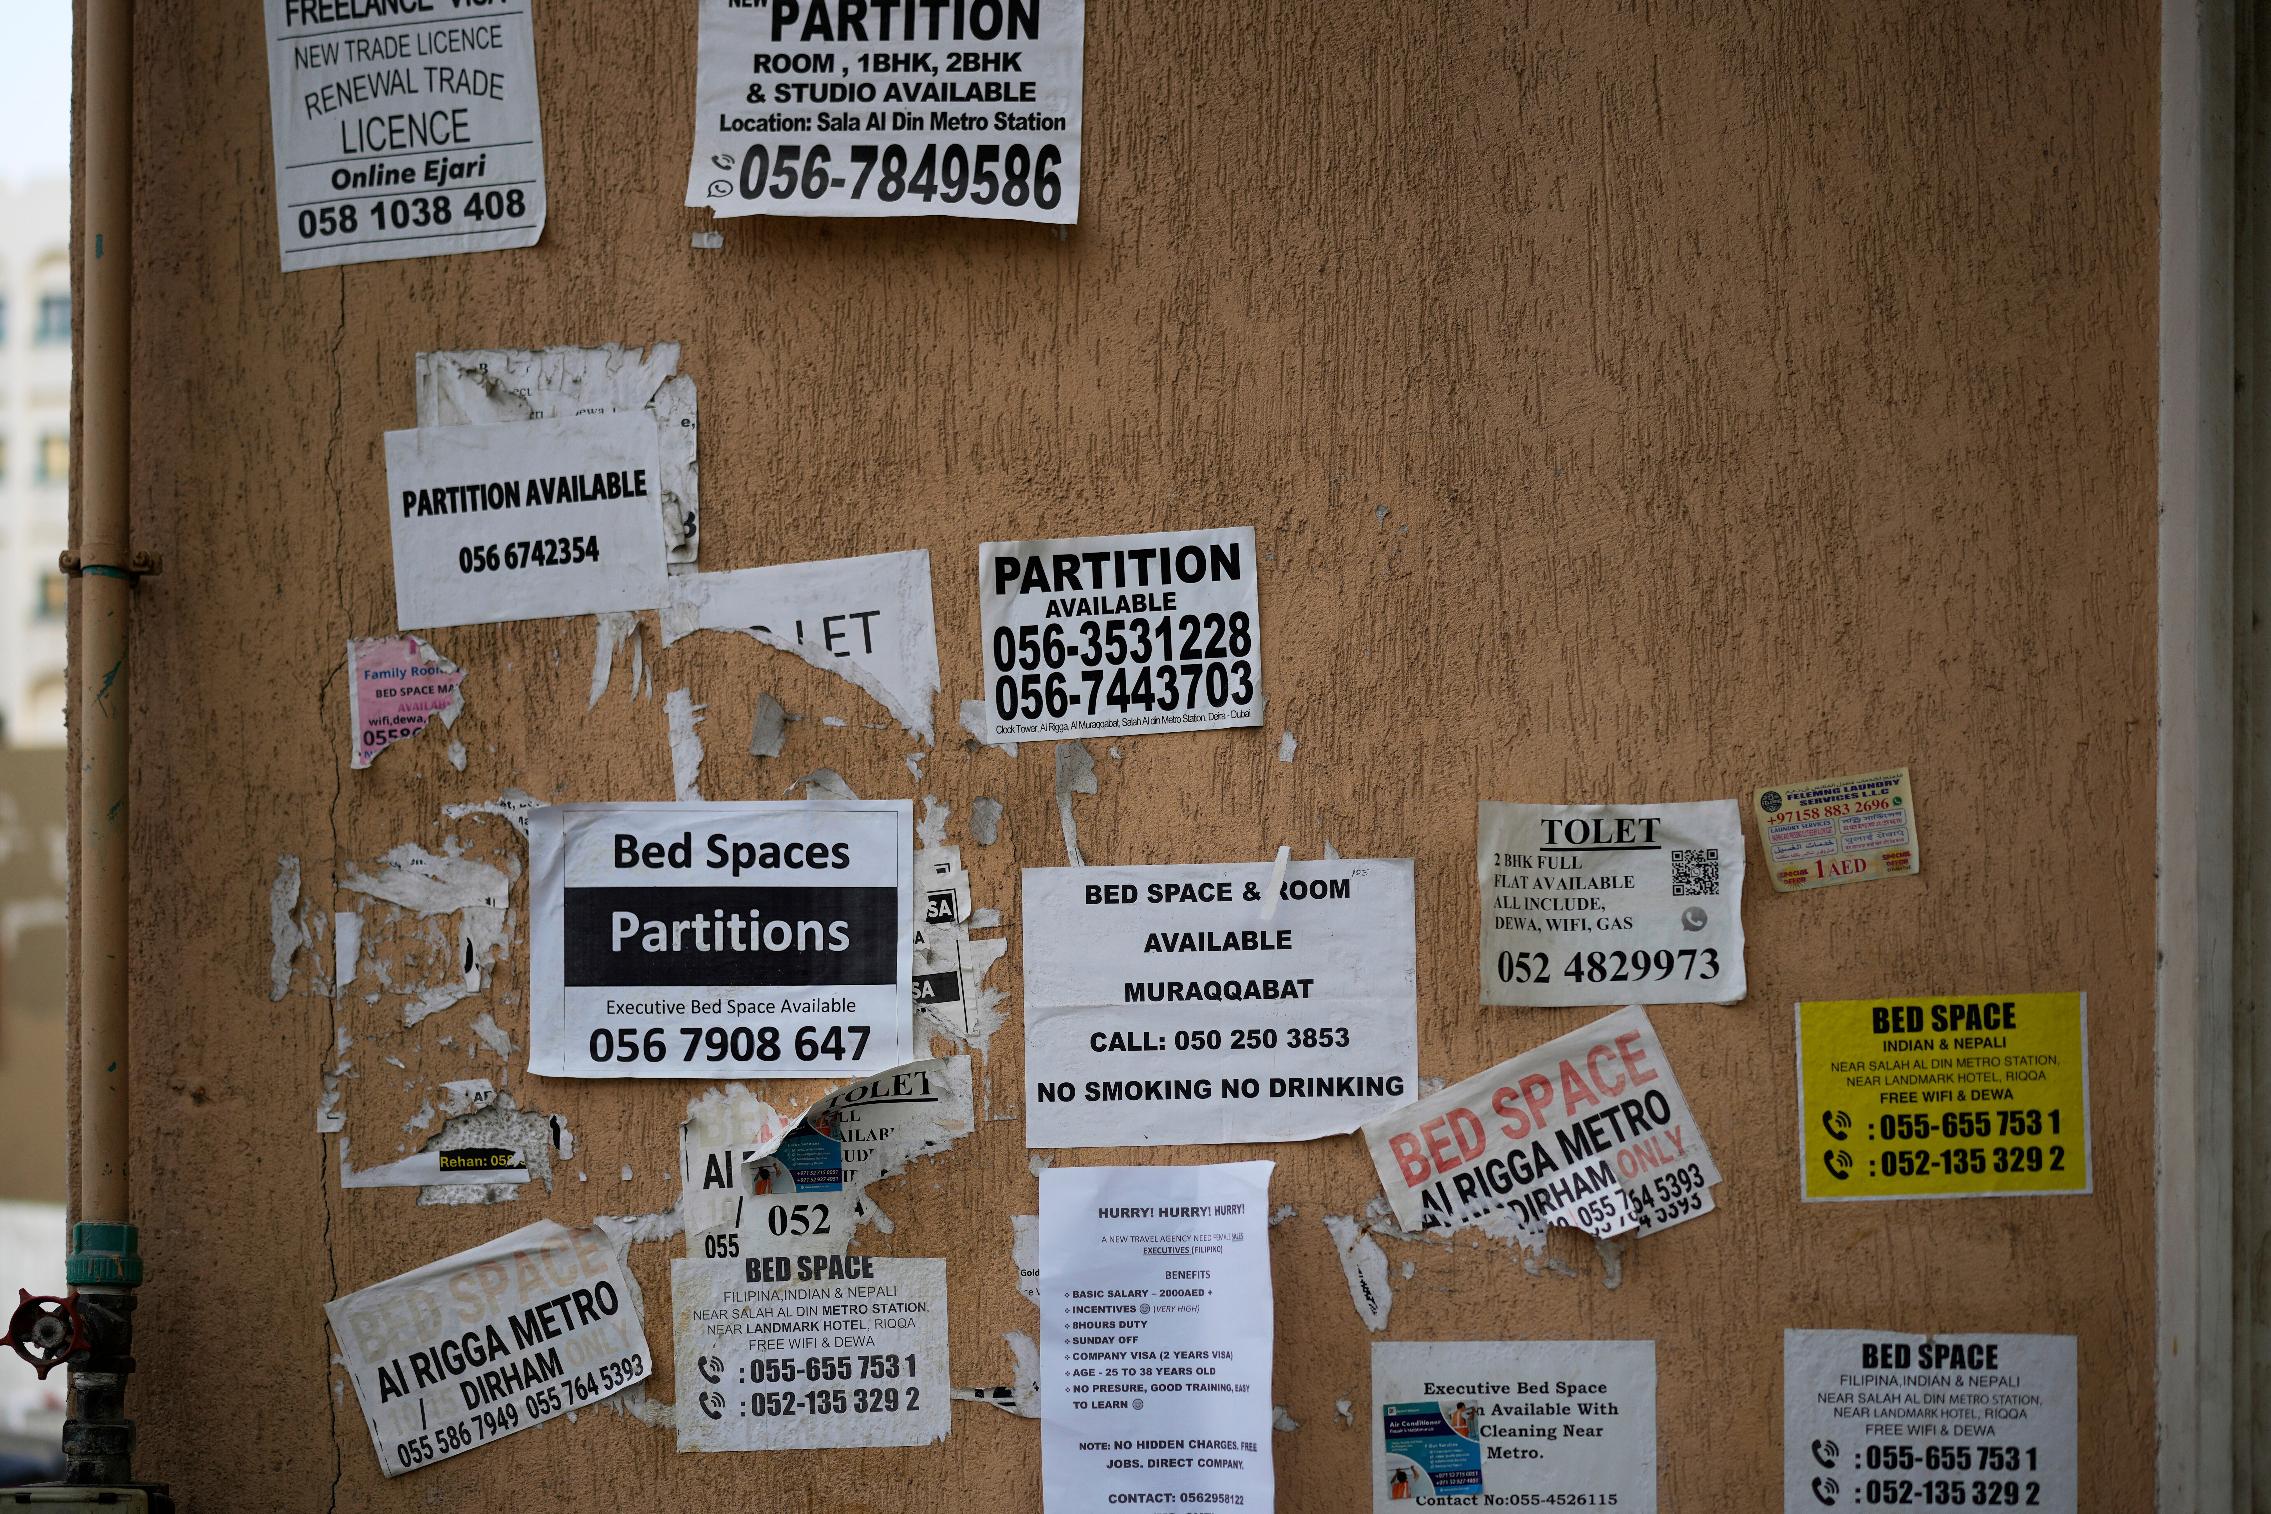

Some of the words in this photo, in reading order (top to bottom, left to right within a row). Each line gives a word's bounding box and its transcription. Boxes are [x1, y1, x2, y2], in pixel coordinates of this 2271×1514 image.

[771, 0, 1039, 42] PARTITION
[295, 43, 339, 70] NEW
[345, 35, 411, 63] TRADE
[417, 25, 502, 56] LICENCE
[754, 54, 834, 73] ROOM
[857, 53, 938, 76] 1BHK,
[947, 52, 1022, 72] 2BHK
[305, 68, 418, 120] RENEWAL
[424, 67, 504, 100] TRADE
[746, 84, 766, 103] &
[775, 84, 876, 102] STUDIO
[884, 82, 1036, 102] AVAILABLE
[342, 109, 470, 154] LICENCE
[720, 114, 811, 132] Location:
[817, 113, 860, 131] Sala
[866, 113, 886, 131] Al
[893, 113, 924, 131] Din
[931, 113, 988, 131] Metro
[994, 113, 1066, 131] Station
[332, 165, 416, 190] Online
[424, 154, 486, 186] Ejari
[740, 143, 1062, 210] 056-7849586
[299, 205, 358, 238] 058
[371, 196, 451, 230] 1038
[464, 190, 526, 221] 408
[403, 481, 520, 518] PARTITION
[526, 470, 647, 506] AVAILABLE
[460, 545, 499, 573] 056
[505, 536, 599, 568] 6742354
[995, 543, 1241, 595] PARTITION
[1046, 592, 1177, 618] AVAILABLE
[994, 611, 1251, 672] 056-3531228
[364, 668, 407, 680] Family
[376, 688, 397, 698] BED
[400, 686, 434, 696] SPACE
[996, 660, 1253, 720] 056-7443703
[996, 725, 1015, 734] Clock
[1162, 715, 1181, 724] Metro
[1844, 779, 1900, 793] LAUNDRY
[1768, 808, 1820, 825] +97158
[1825, 803, 1850, 816] 883
[1856, 798, 1889, 813] 2696
[1800, 793, 1859, 806] SERVICES
[1541, 818, 1661, 845] TOLET
[1770, 824, 1800, 833] LAUNDRY
[1802, 821, 1831, 829] SERVICES
[615, 832, 691, 869] Bed
[706, 833, 850, 877] Spaces
[1494, 853, 1500, 866] 2
[1505, 854, 1532, 869] BHK
[1537, 856, 1583, 870] FULL
[1829, 859, 1867, 877] AED
[1085, 884, 1138, 905] BED
[1147, 882, 1232, 903] SPACE
[1243, 882, 1260, 902] &
[1494, 874, 1528, 889] FLAT
[1533, 876, 1635, 890] AVAILABLE
[1493, 896, 1520, 909] ALL
[1524, 897, 1605, 912] INCLUDE,
[612, 909, 850, 953] Partitions
[1495, 916, 1541, 934] DEWA,
[1546, 918, 1592, 933] WIFI,
[1596, 916, 1633, 931] GAS
[1144, 930, 1292, 953] AVAILABLE
[1498, 951, 1550, 983] 052
[1564, 948, 1720, 983] 4829973
[1124, 979, 1314, 1005] MURAQQABAT
[607, 1001, 685, 1015] Executive
[691, 999, 721, 1014] Bed
[727, 999, 775, 1018] Space
[781, 997, 856, 1014] Available
[1872, 1006, 1923, 1034] BED
[1931, 1002, 2016, 1031] SPACE
[589, 1027, 666, 1063] 056
[680, 1026, 781, 1062] 7908
[795, 1025, 871, 1061] 647
[1090, 1032, 1166, 1052] CALL:
[1175, 1030, 1221, 1051] 050
[1230, 1029, 1277, 1049] 250
[1287, 1028, 1350, 1048] 3853
[1883, 1040, 1934, 1052] INDIAN
[1940, 1039, 1949, 1050] &
[1954, 1037, 2006, 1049] NEPALI
[1037, 1082, 1075, 1103] NO
[1085, 1080, 1211, 1102] SMOKING
[1221, 1079, 1260, 1099] NO
[1269, 1075, 1404, 1098] DRINKING
[1880, 1092, 1918, 1104] FREE
[1923, 1091, 1952, 1102] WIFI
[1957, 1090, 1966, 1101] &
[1971, 1089, 2014, 1100] DEWA
[1389, 1107, 1487, 1188] BED
[1491, 1029, 1659, 1141] SPACE
[1452, 1140, 1559, 1201] RIGGA
[1555, 1089, 1671, 1165] METRO
[1616, 1125, 1688, 1179] ONLY
[440, 1155, 487, 1169] Rehan:
[768, 1204, 830, 1236] 052
[1099, 1207, 1153, 1218] HURRY!
[1159, 1206, 1211, 1217] HURRY!
[1215, 1204, 1244, 1216] HURRY!
[705, 1234, 739, 1258] 055
[746, 1257, 791, 1282] BED
[798, 1254, 874, 1282] SPACE
[1166, 1270, 1210, 1279] BENEFITS
[1108, 1290, 1148, 1298] SALARY
[409, 1325, 511, 1389] RIGGA
[508, 1281, 618, 1350] METRO
[1073, 1321, 1115, 1329] 8HOURS
[1119, 1336, 1138, 1344] OFF
[1862, 1344, 1911, 1369] BED
[1919, 1343, 1998, 1369] SPACE
[459, 1348, 564, 1410] DIRHAM
[1424, 1383, 1510, 1395] Executive
[1517, 1382, 1549, 1394] Bed
[1556, 1382, 1607, 1397] Space
[397, 1436, 433, 1467] 055
[435, 1426, 472, 1454] 586
[471, 1404, 518, 1440] 7949
[526, 1391, 562, 1419] 055
[562, 1372, 599, 1405] 764
[601, 1354, 644, 1391] 5393
[1480, 1425, 1557, 1440] Cleaning
[1563, 1425, 1603, 1437] Near
[1487, 1447, 1543, 1459] Metro.
[1109, 1494, 1176, 1503] CONTACT:
[1180, 1493, 1243, 1505] 0562958122
